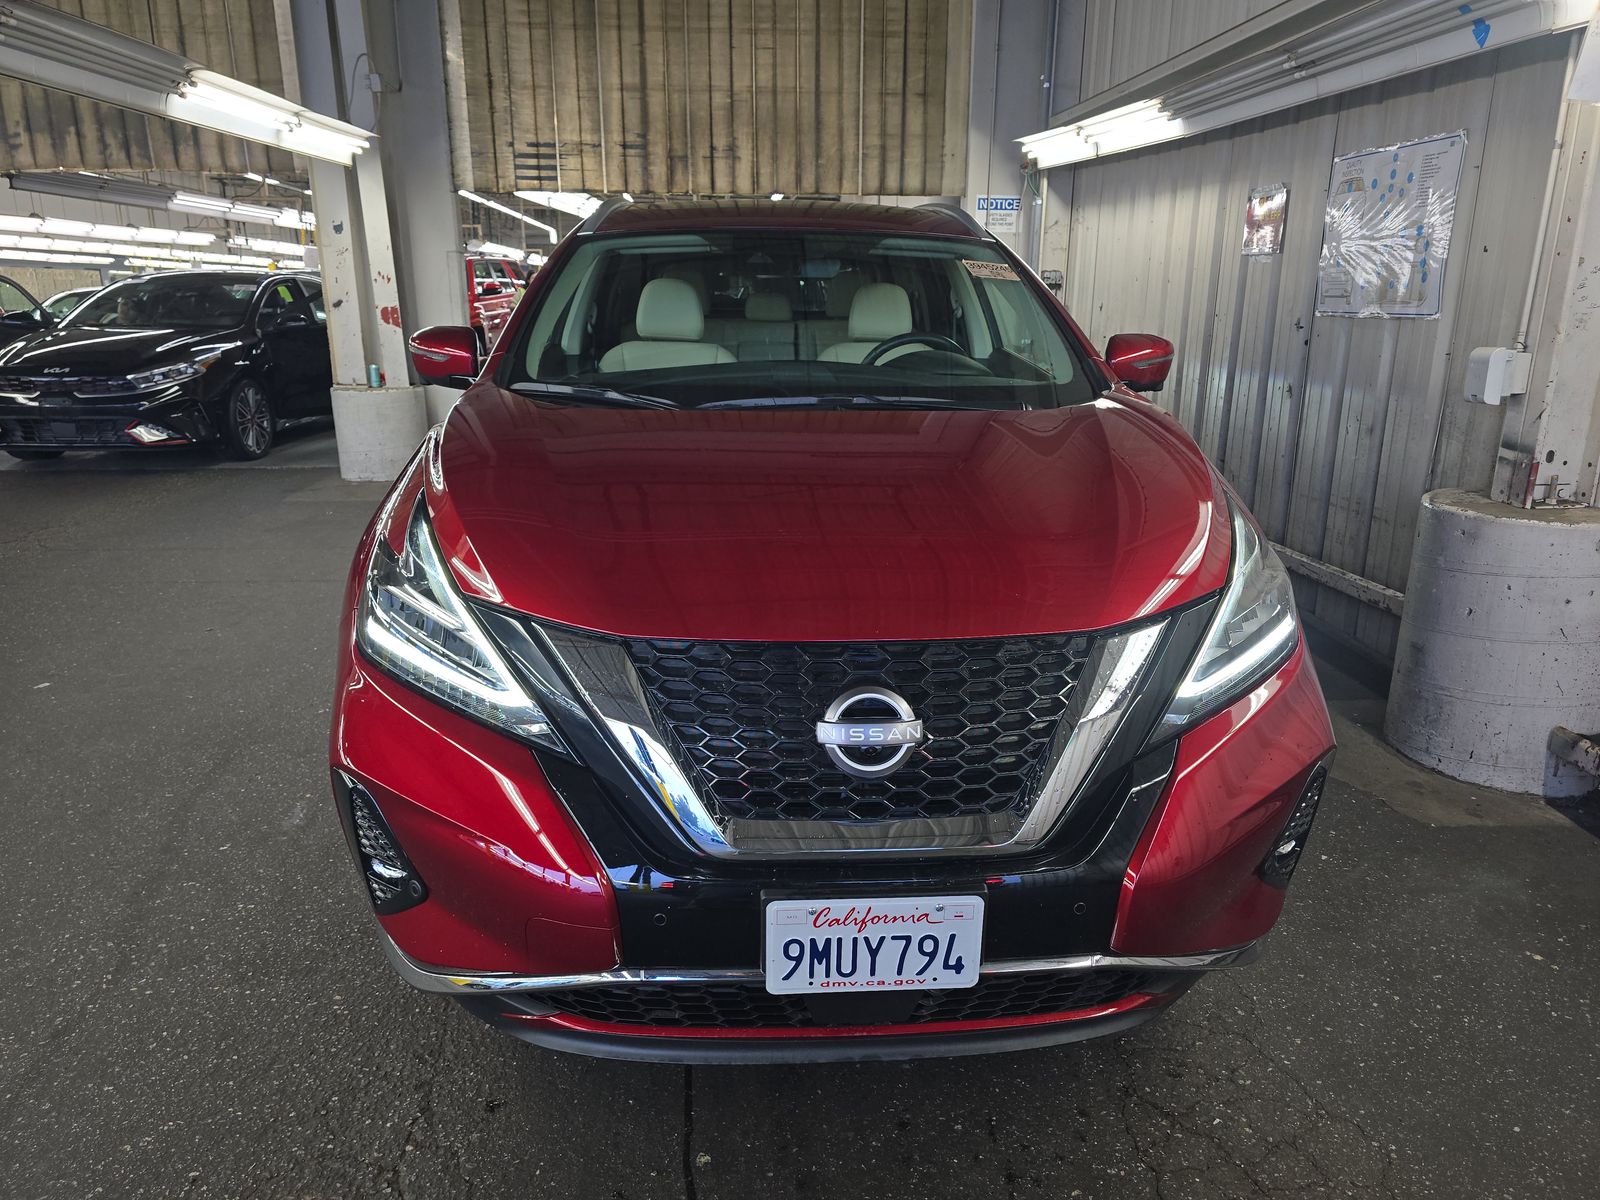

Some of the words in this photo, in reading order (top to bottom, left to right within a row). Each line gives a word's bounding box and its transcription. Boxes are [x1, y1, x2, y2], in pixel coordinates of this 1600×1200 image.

[979, 199, 1020, 209] NOTICE
[820, 726, 921, 741] NISSAN
[812, 907, 944, 933] California
[781, 933, 965, 980] 9MUY794
[820, 978, 927, 988] dmv.ca.gov
